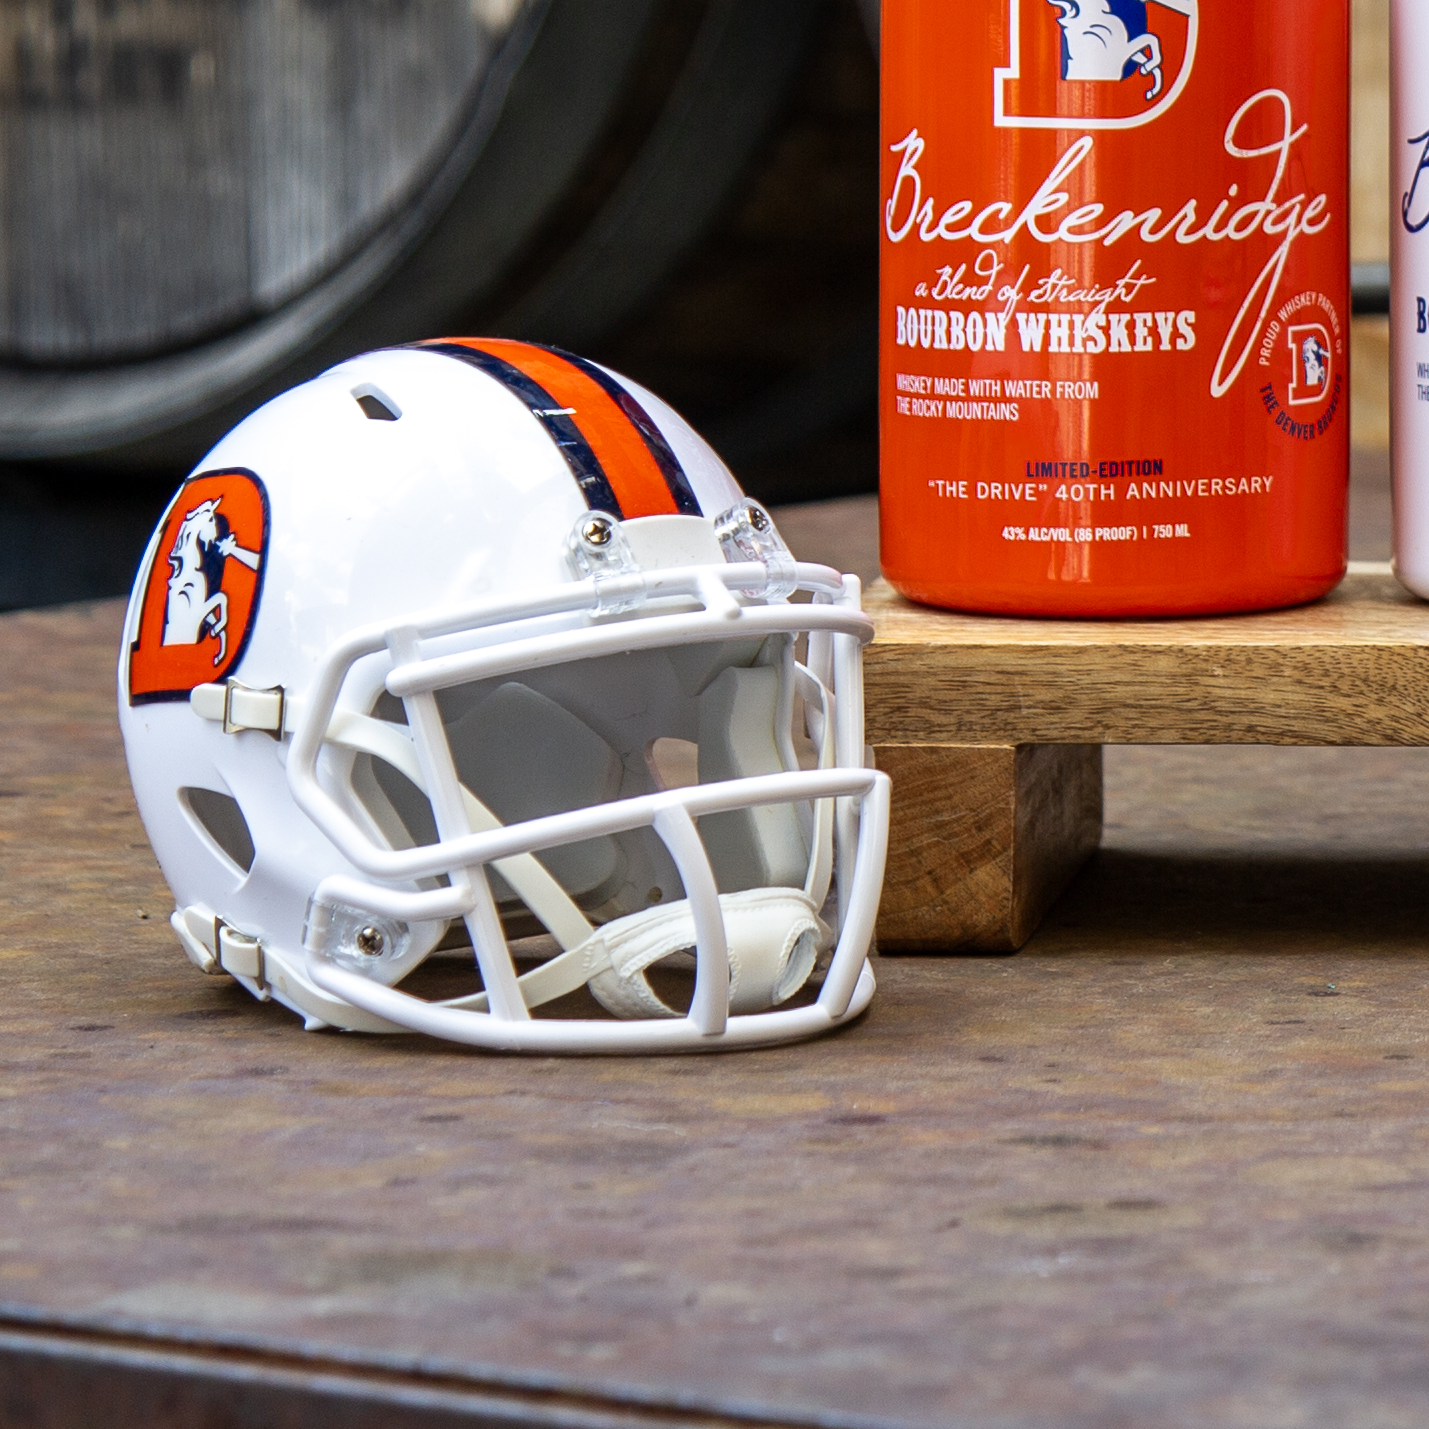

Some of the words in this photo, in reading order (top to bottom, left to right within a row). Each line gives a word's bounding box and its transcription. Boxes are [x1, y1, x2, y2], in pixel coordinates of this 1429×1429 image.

[886, 88, 1331, 398] Breckenridge
[914, 281, 927, 297] a
[932, 249, 1003, 301] Blend
[997, 263, 1030, 324] of
[1027, 259, 1156, 337] Straight
[896, 305, 1006, 352] BOURBON
[1016, 310, 1197, 354] WHISKEYS
[1258, 319, 1281, 366] PROUD
[1277, 291, 1316, 322] WHISKEY
[896, 373, 932, 396] WHISKEY
[934, 376, 966, 397] MADE
[968, 378, 1001, 398] WITH
[1003, 379, 1051, 399] WATER
[1055, 380, 1099, 400] FROM
[896, 395, 910, 416] THE
[911, 397, 944, 418] ROCKY
[946, 400, 1019, 421] MOUNTAINS
[1025, 459, 1164, 479] LIMITED-EDITION
[1055, 483, 1115, 502] 40TH
[1126, 475, 1274, 500] ANNIVERSARY
[1001, 526, 1026, 541] 43%
[1028, 526, 1072, 542] ALC/VOL
[1074, 526, 1093, 543] (86
[1095, 525, 1138, 542] PROOF)
[1152, 524, 1174, 540] 750
[1175, 523, 1191, 538] ML
